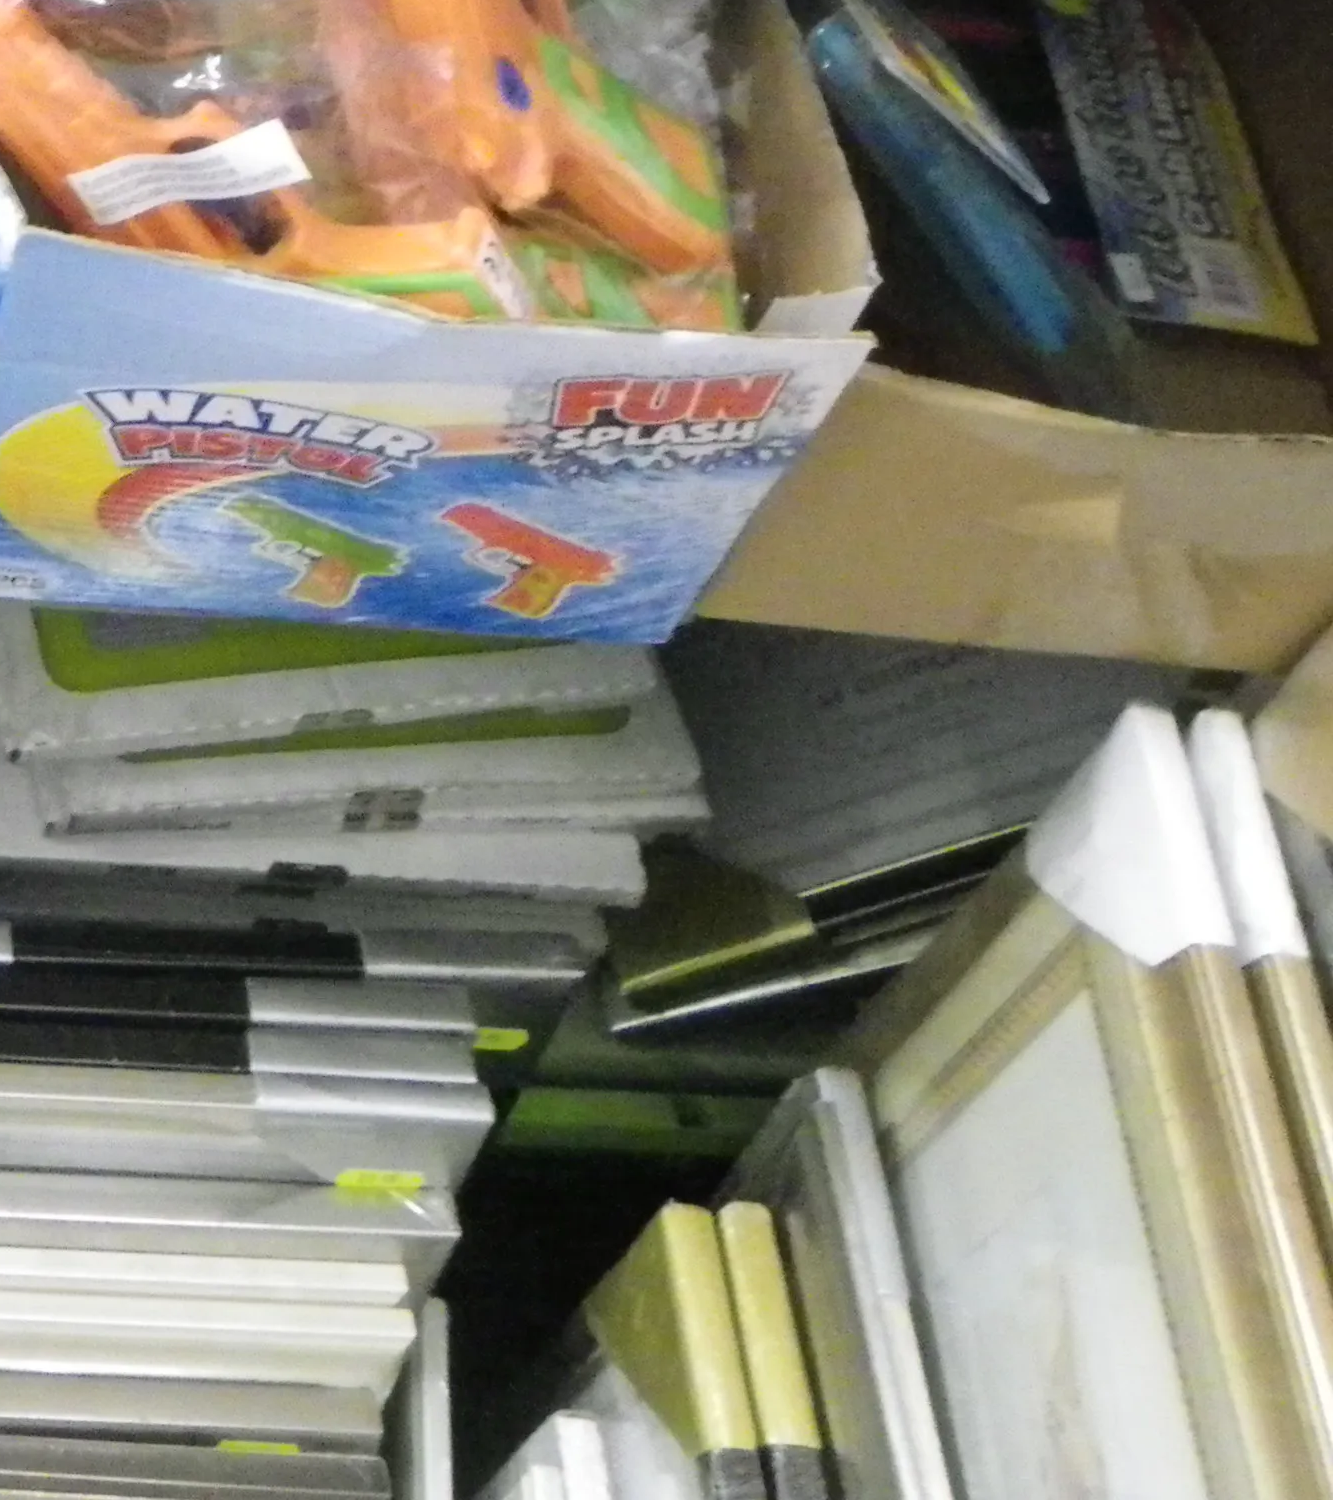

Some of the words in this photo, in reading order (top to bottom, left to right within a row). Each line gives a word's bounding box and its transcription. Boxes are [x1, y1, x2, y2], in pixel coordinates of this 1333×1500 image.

[87, 388, 435, 458] WATER
[553, 372, 789, 428] FUN
[113, 426, 385, 484] PISTOL
[553, 418, 760, 450] SPLASH
